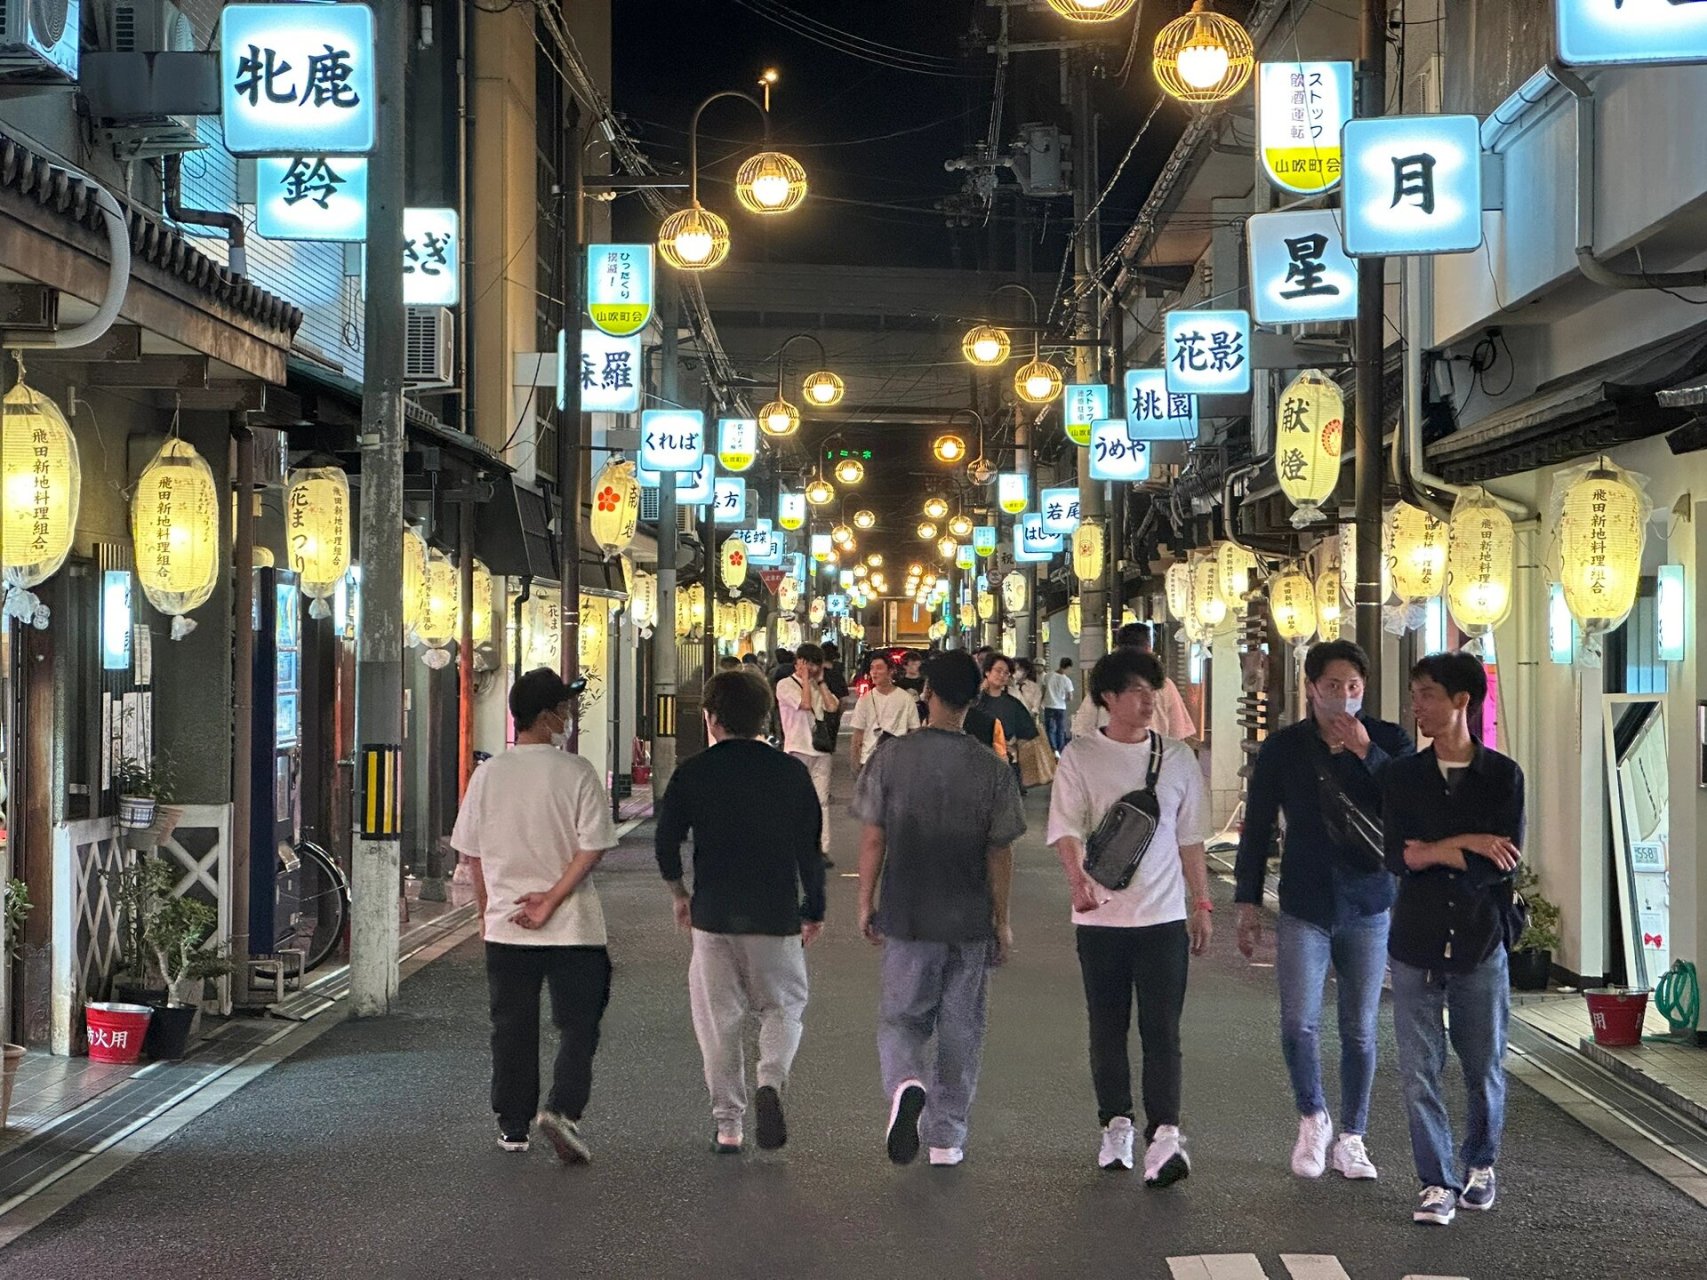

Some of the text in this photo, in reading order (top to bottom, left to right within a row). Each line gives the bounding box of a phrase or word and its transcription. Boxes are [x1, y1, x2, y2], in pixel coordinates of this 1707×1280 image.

[234, 44, 361, 108] 牝鹿
[280, 157, 347, 210] 鈴
[1275, 157, 1341, 173] 山吹町会
[1390, 153, 1437, 214] 月
[620, 252, 631, 300] ひったくり
[1279, 233, 1340, 300] 星
[596, 311, 643, 322] 山吹町会
[1171, 331, 1245, 373] 花影
[1132, 388, 1192, 421] 桃園
[645, 432, 699, 450] くれば
[1095, 436, 1146, 462] うめや
[1280, 397, 1311, 483] 献燈
[32, 428, 50, 550] 飛田新地料理組合
[1046, 502, 1080, 521] 若尾
[157, 476, 172, 579] 飛田新地料理組合
[291, 486, 310, 574] 花まつり
